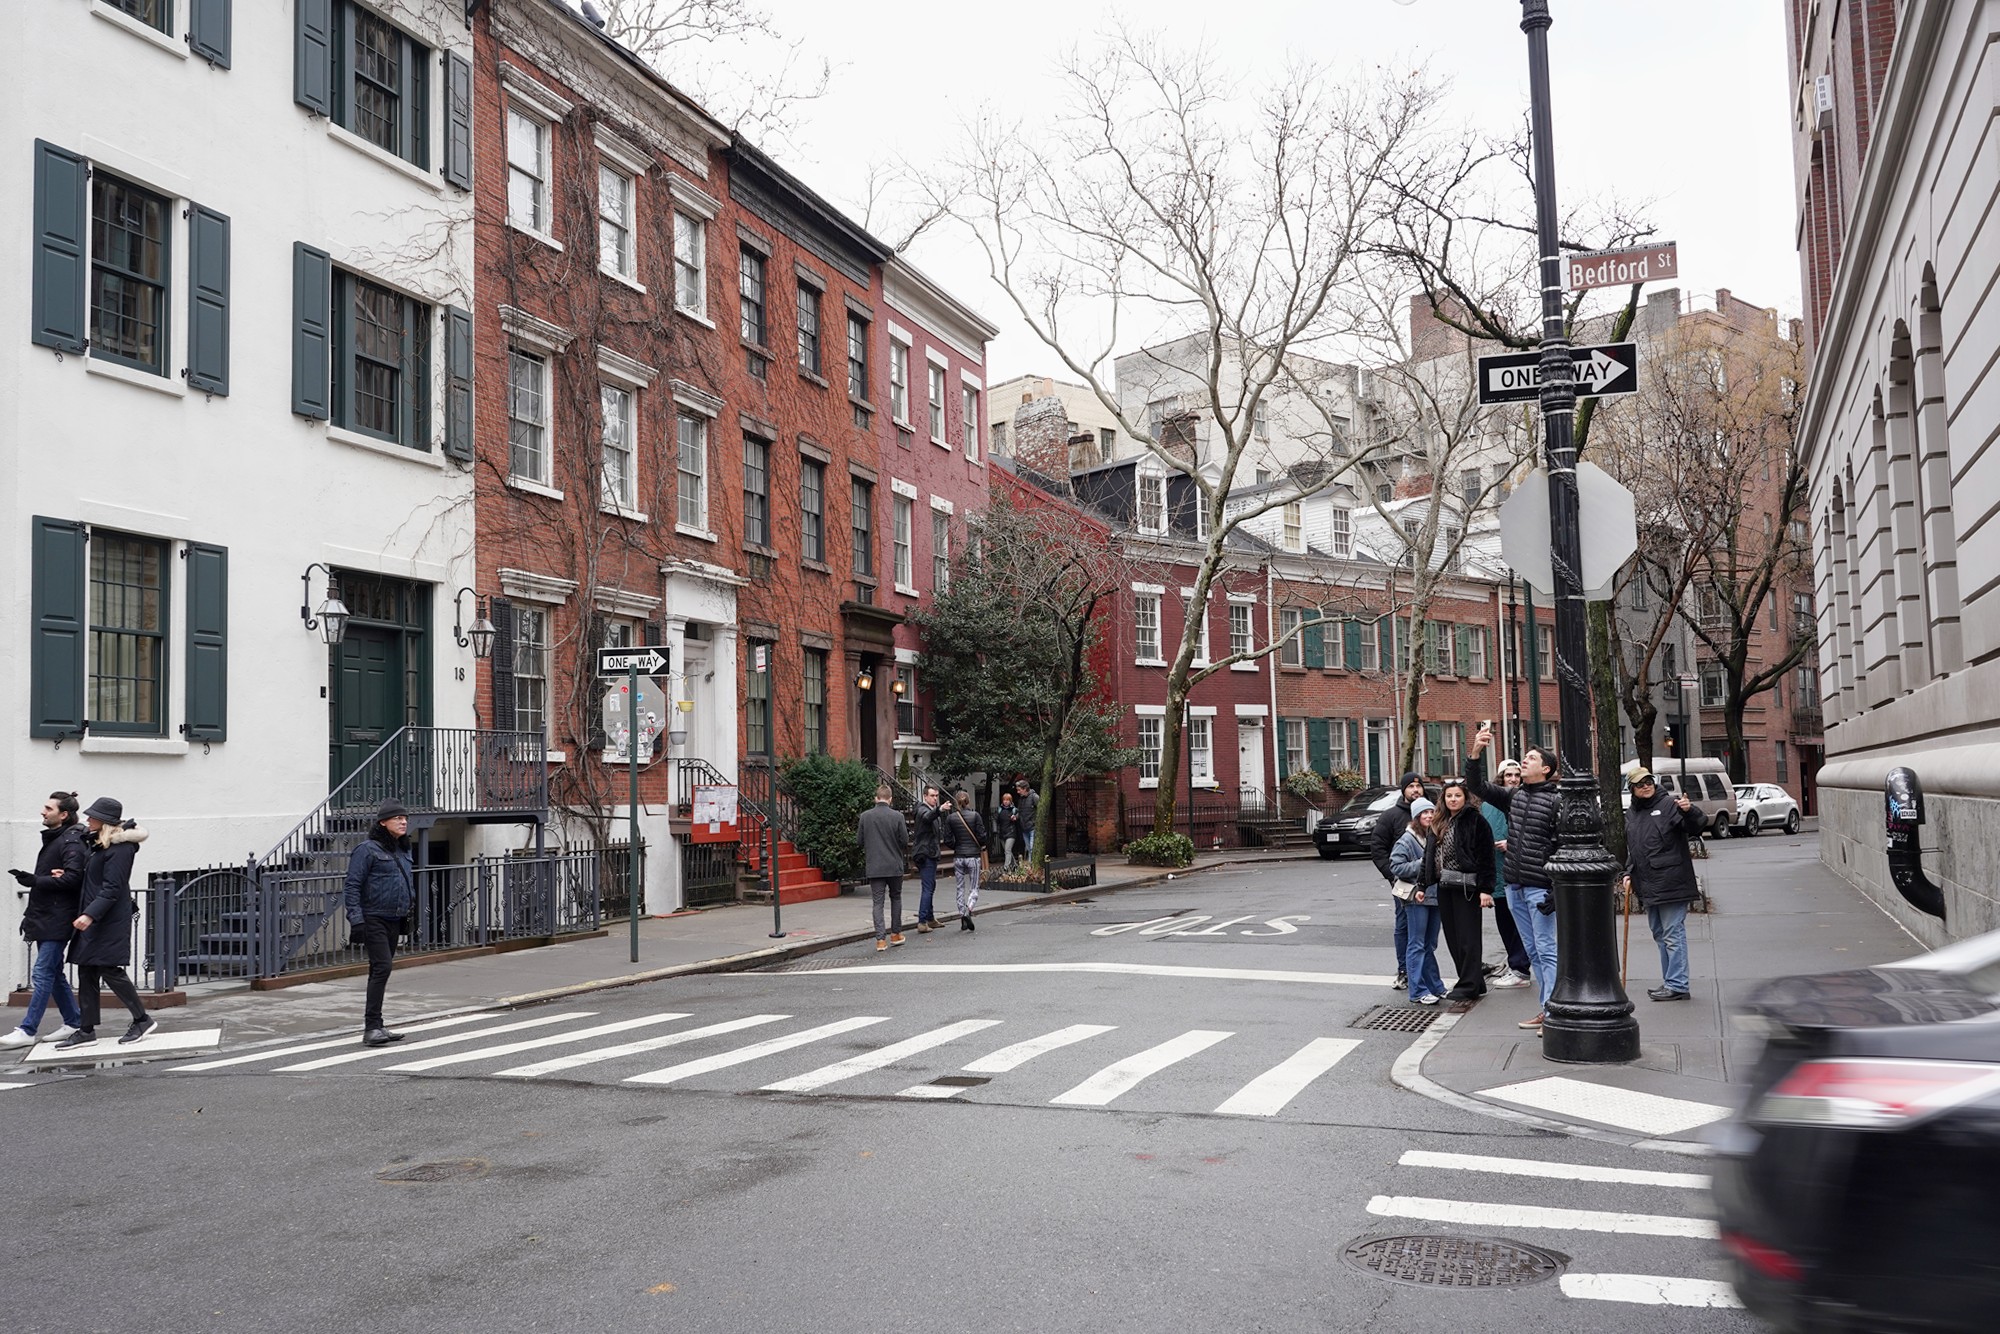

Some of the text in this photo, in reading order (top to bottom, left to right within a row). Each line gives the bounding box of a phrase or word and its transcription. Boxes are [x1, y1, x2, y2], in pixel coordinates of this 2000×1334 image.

[1572, 253, 1671, 287] Bedford St
[1501, 367, 1541, 388] ONE
[608, 656, 659, 668] ONE WAY
[454, 667, 465, 681] 18
[1089, 915, 1312, 937] STOP
